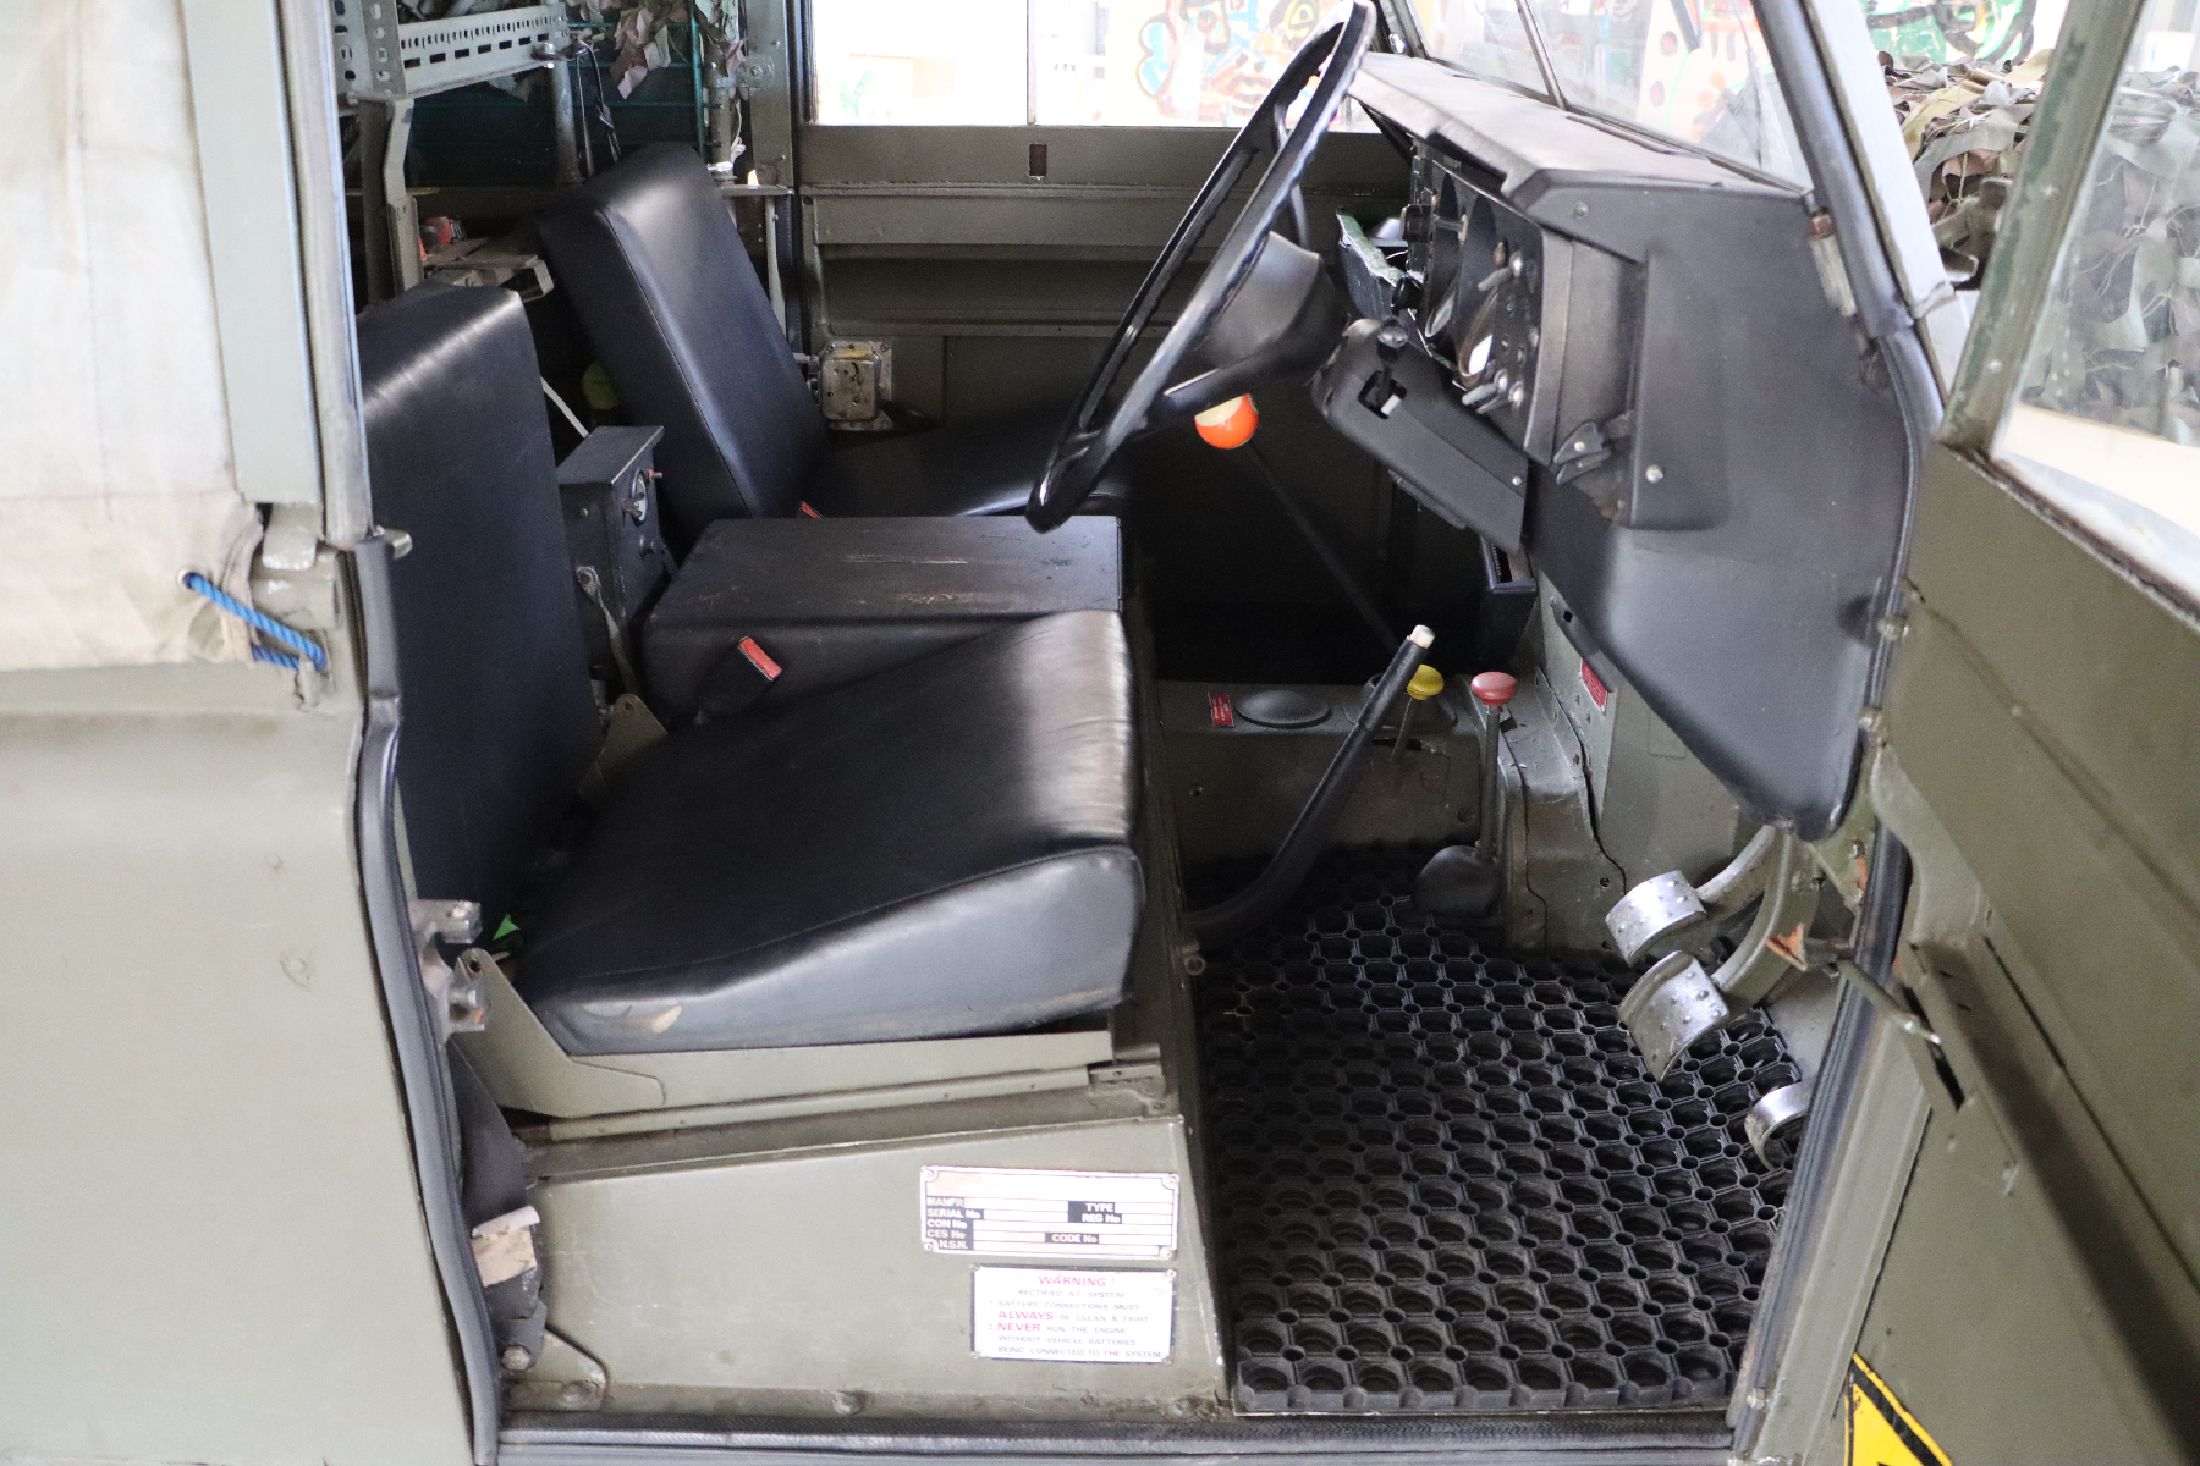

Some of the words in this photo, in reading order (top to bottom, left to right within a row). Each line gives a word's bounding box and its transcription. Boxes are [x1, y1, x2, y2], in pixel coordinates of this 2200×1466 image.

[1085, 1202, 1113, 1212] TYPE
[928, 1208, 964, 1218] SERIAL
[1052, 1233, 1081, 1243] CODE
[1088, 1290, 1124, 1298] SYSTEM
[1043, 1301, 1108, 1310] CONNECTIONS
[998, 1310, 1054, 1320] ALWAYS
[997, 1322, 1041, 1331] NEVER
[1046, 1336, 1084, 1344] VEHICLE
[1088, 1338, 1136, 1346] BATTERIES
[1029, 1347, 1084, 1356] CONNECTED
[1125, 1350, 1162, 1358] SYSTEM
